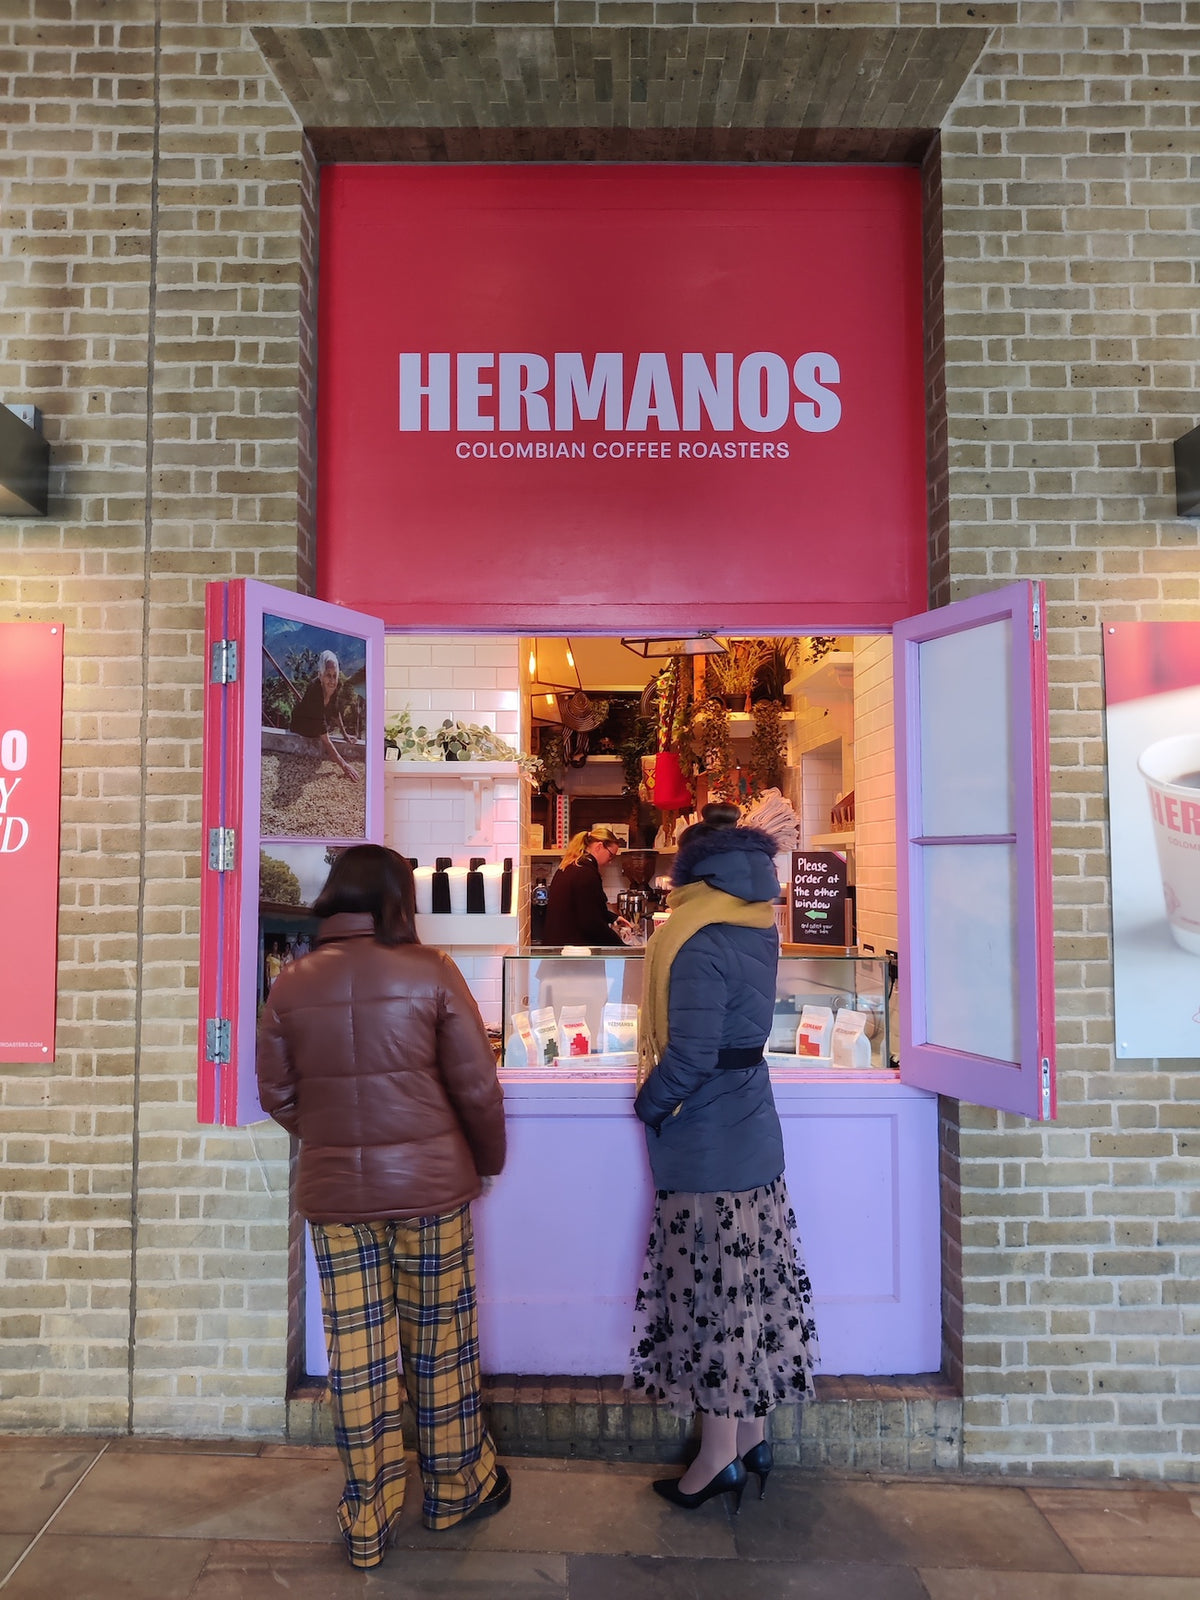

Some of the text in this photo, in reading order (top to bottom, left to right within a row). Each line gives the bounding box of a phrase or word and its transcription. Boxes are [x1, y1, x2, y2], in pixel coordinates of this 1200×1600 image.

[399, 351, 841, 432] HERMANOS
[455, 442, 790, 459] COLOMBIAN COFFEE ROASTERS
[0, 816, 29, 853] D
[797, 857, 828, 873] Please
[827, 873, 840, 884] at
[794, 886, 840, 897] the other
[795, 899, 831, 909] window
